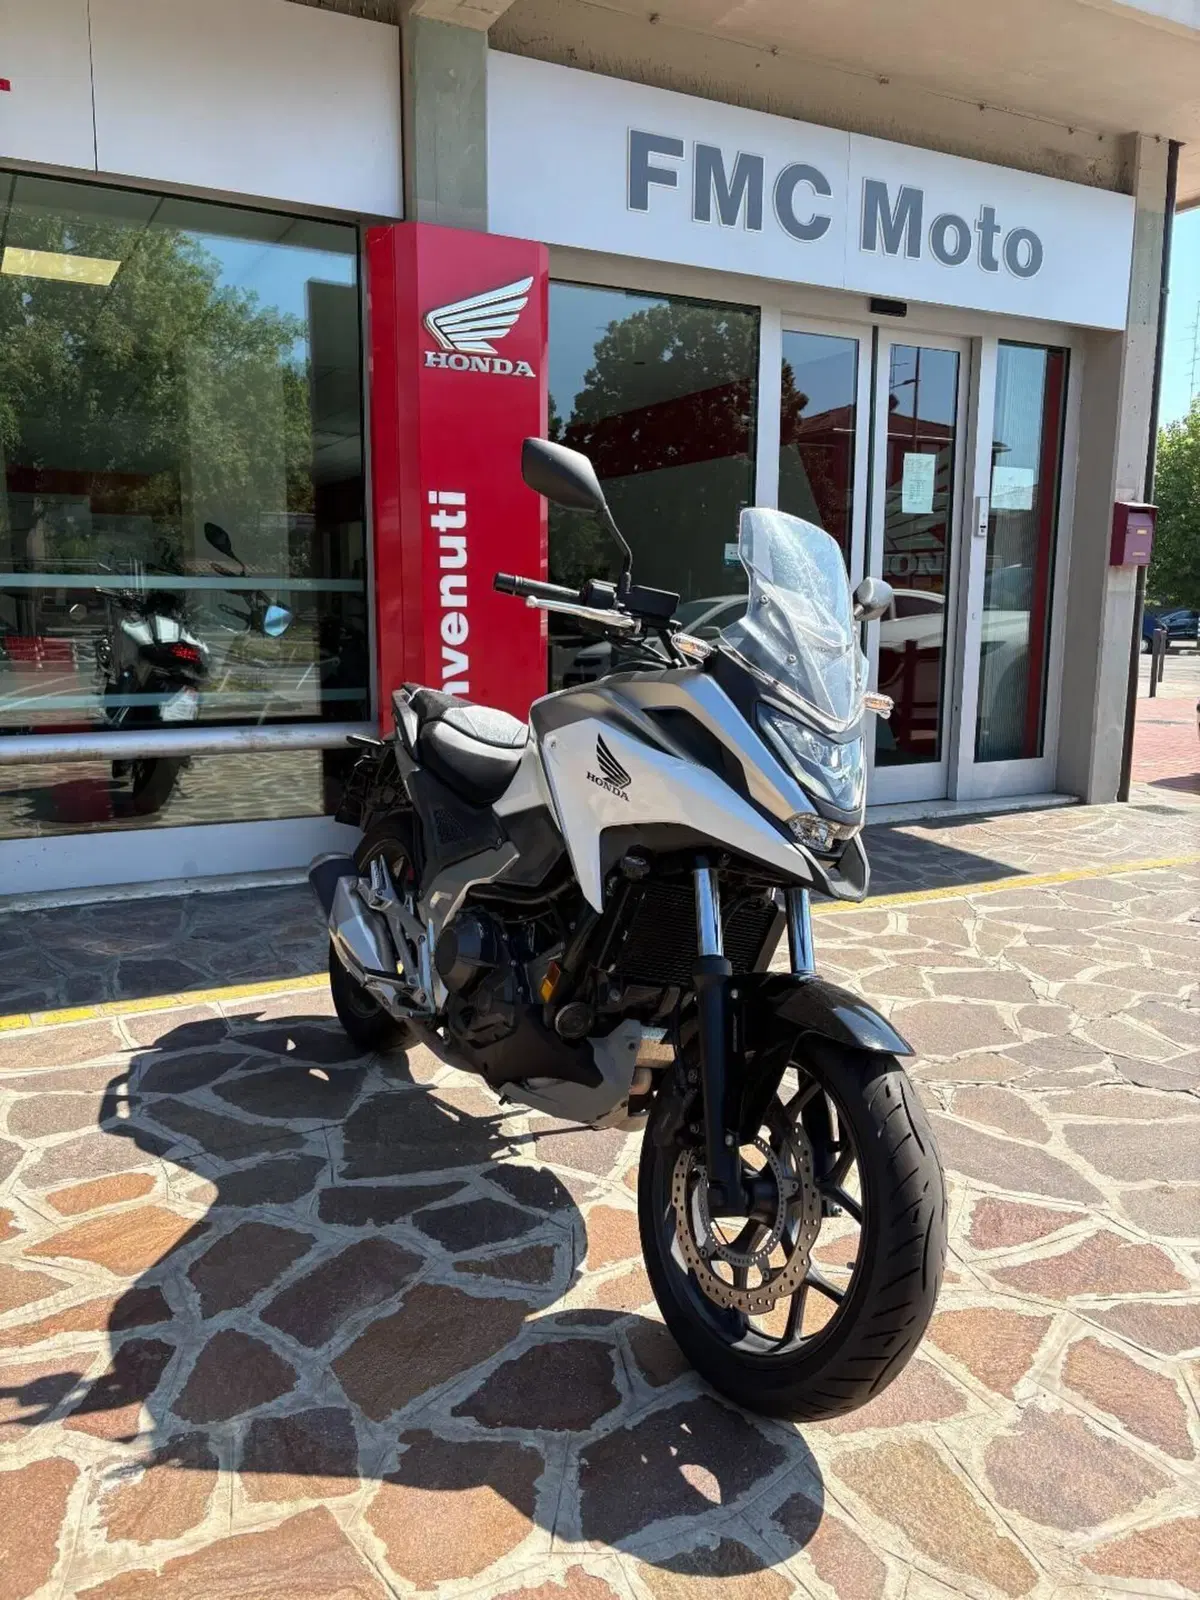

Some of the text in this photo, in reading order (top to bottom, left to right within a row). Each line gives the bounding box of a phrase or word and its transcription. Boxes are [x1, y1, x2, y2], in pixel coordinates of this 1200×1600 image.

[627, 126, 1044, 280] FMC Moto
[424, 350, 537, 378] HONDA
[586, 770, 630, 802] HONDA
